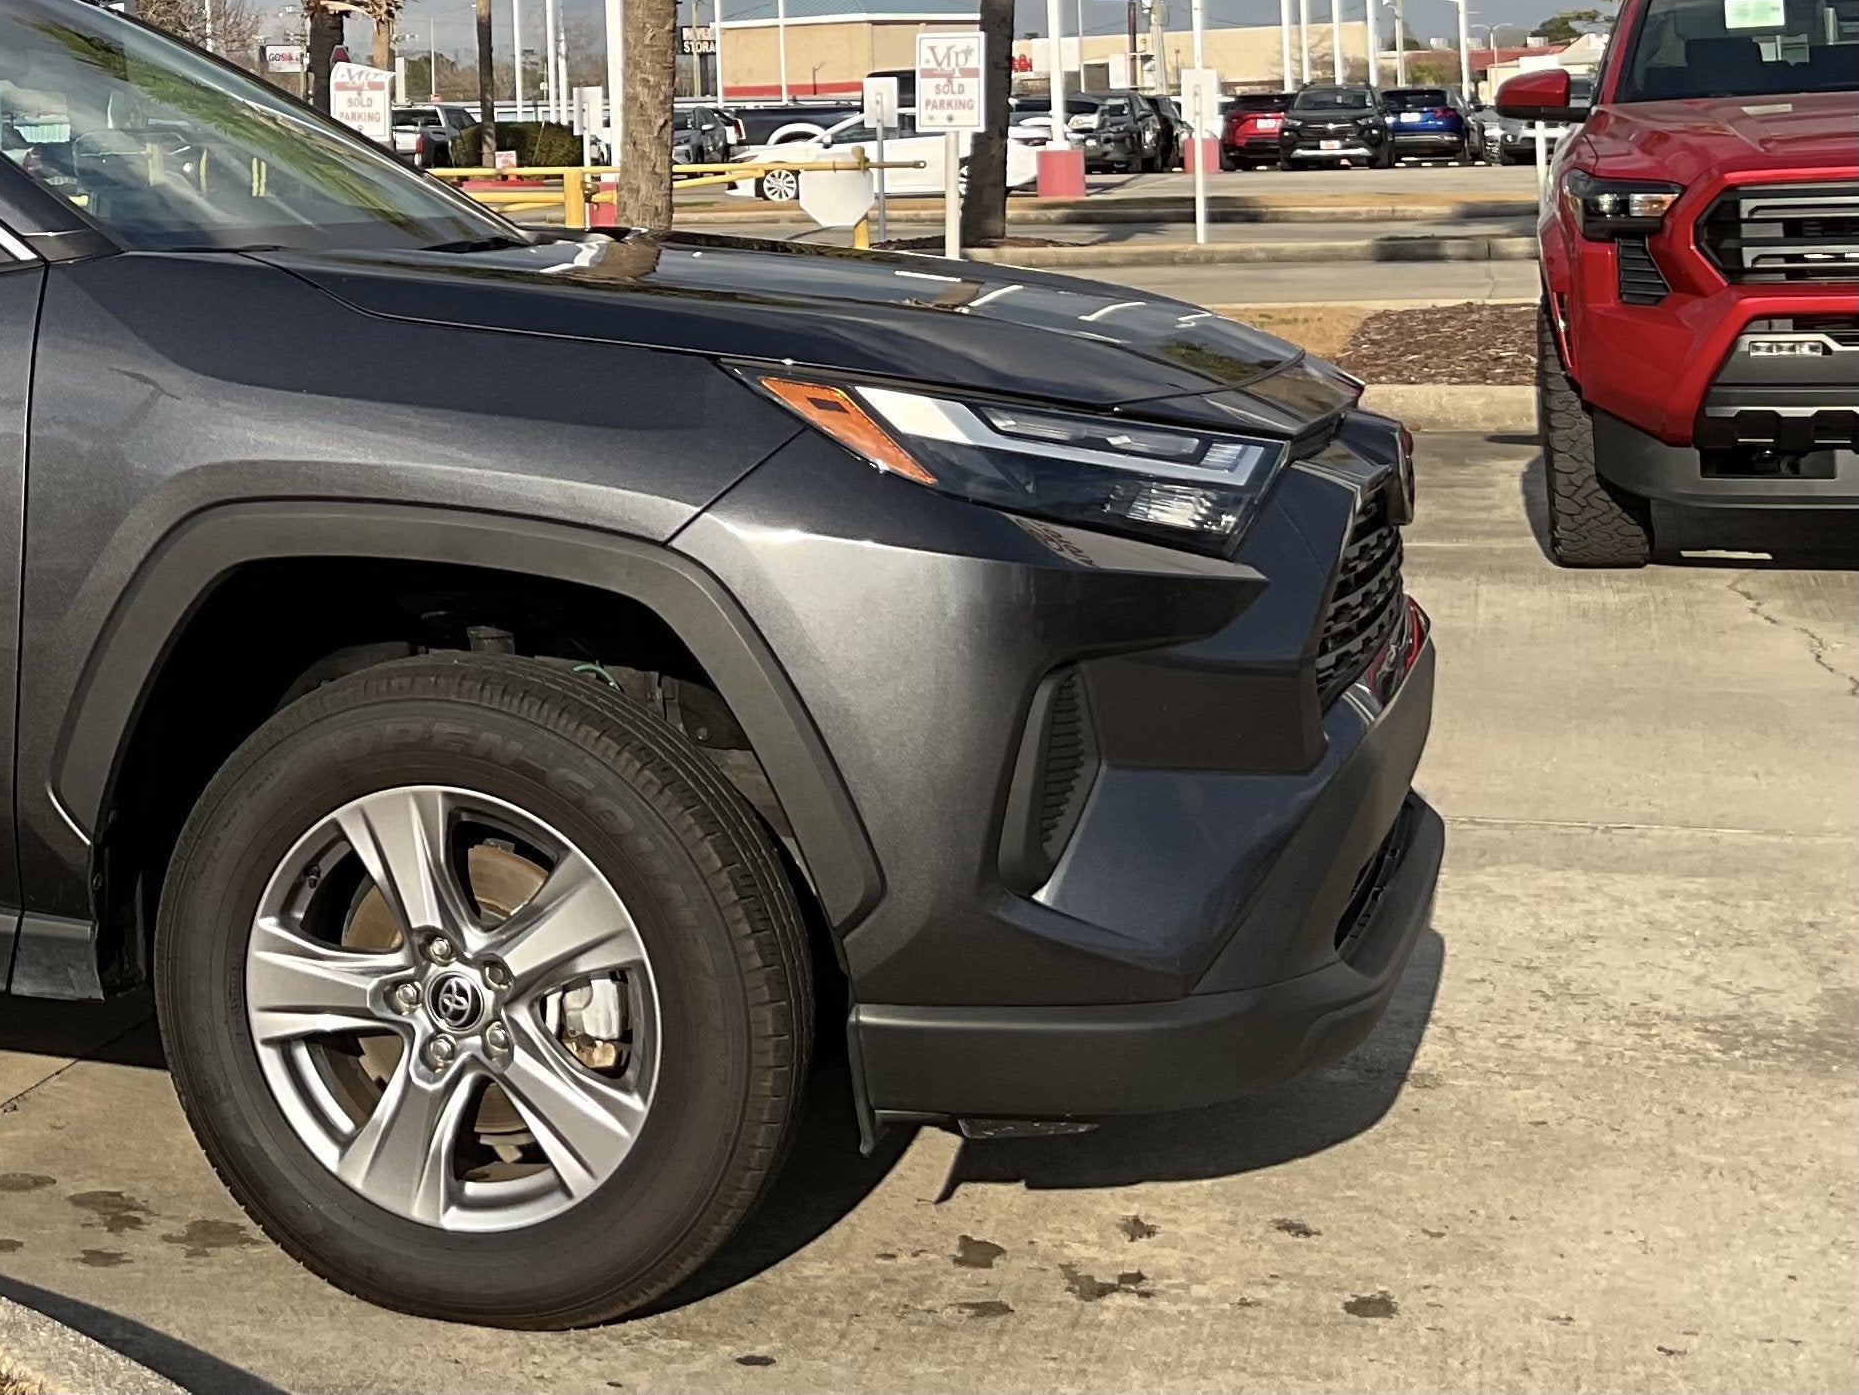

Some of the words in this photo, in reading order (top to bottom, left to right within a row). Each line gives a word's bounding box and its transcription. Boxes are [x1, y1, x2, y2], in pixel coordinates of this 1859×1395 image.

[935, 83, 965, 95] SOLD
[347, 97, 373, 108] SOLD
[924, 99, 975, 111] PARKING
[339, 111, 381, 123] PARKING
